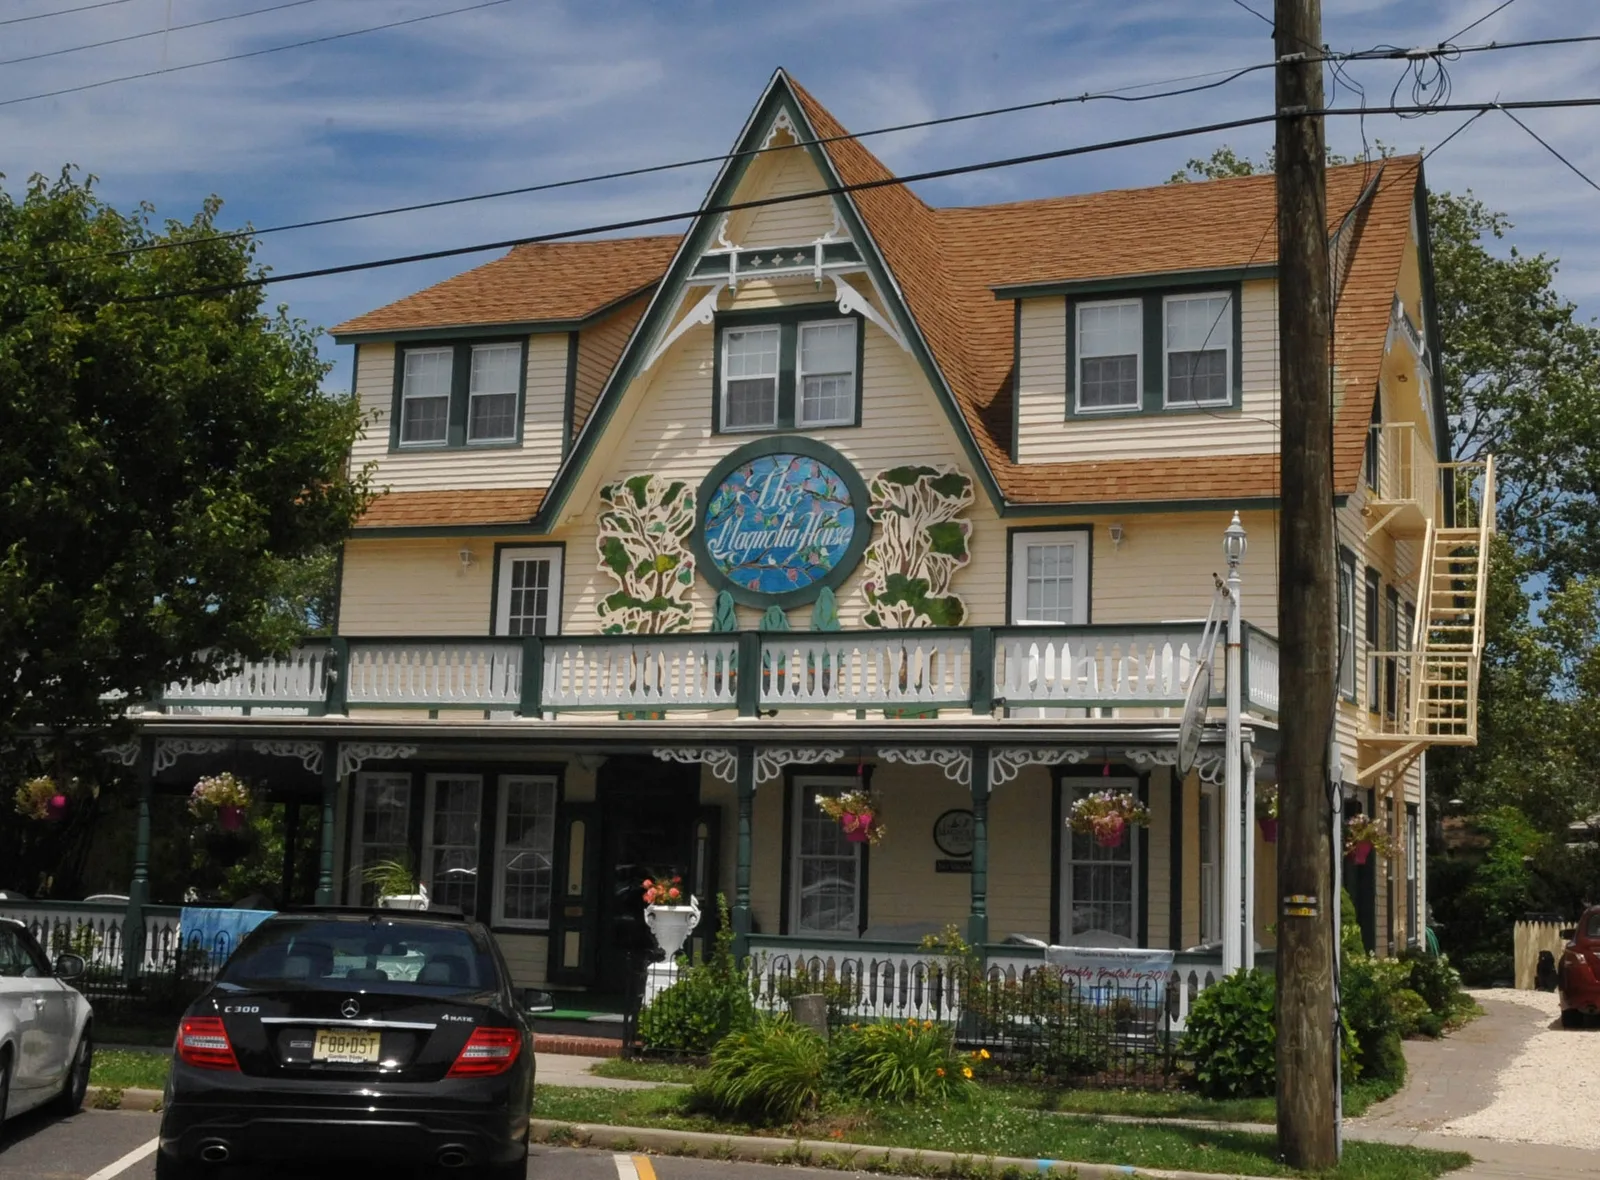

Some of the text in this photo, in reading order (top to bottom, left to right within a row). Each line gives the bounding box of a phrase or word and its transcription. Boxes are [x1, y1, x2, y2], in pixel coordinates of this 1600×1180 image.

[745, 466, 804, 509] The
[707, 506, 852, 565] Magnolia House
[224, 1005, 260, 1014] C 300
